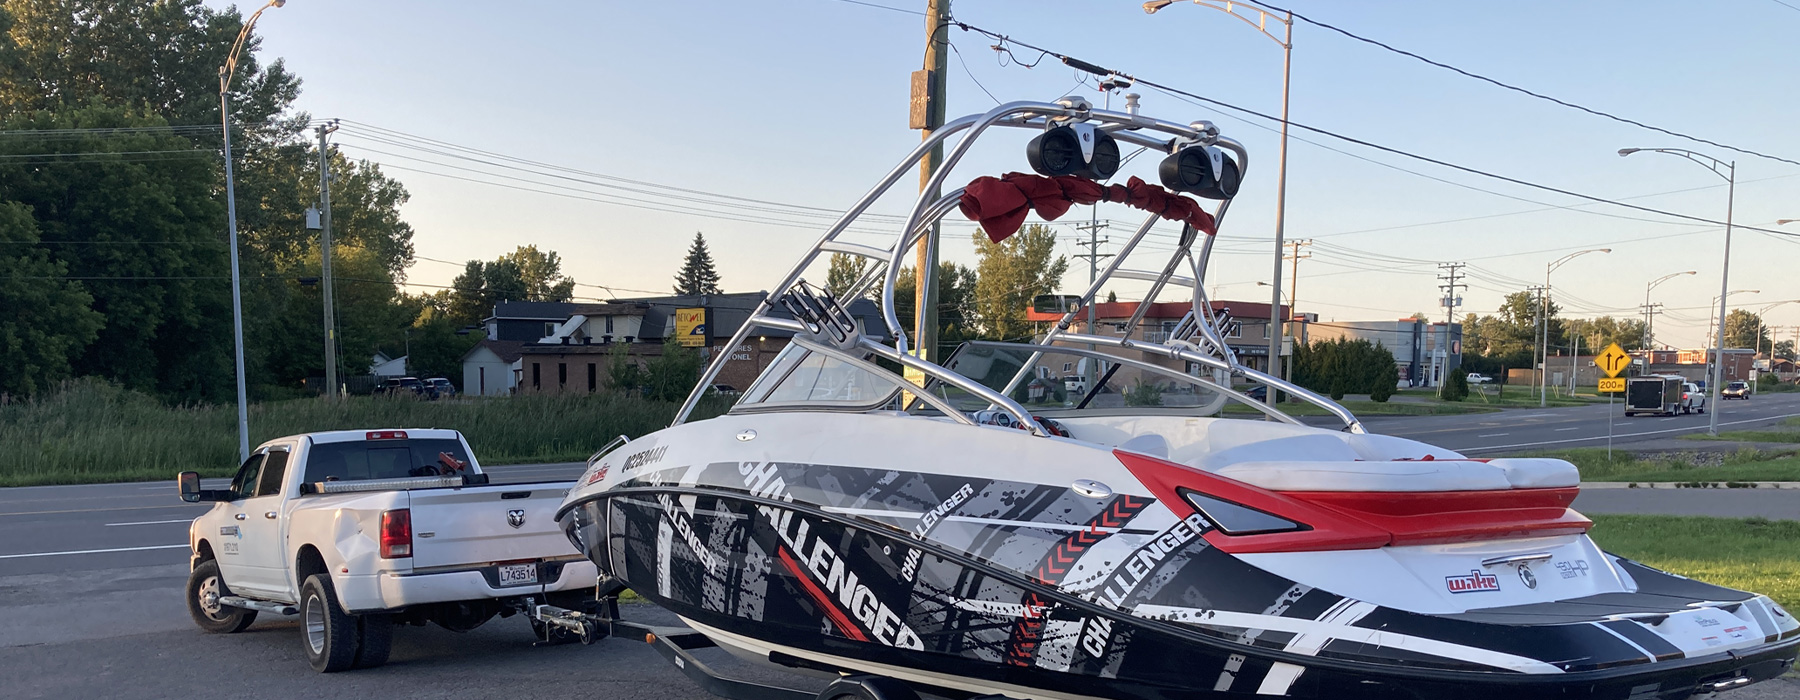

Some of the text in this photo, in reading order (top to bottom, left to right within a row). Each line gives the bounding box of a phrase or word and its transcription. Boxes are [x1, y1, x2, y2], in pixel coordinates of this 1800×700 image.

[1600, 381, 1617, 389] 200
[500, 568, 535, 582] L743514
[1448, 571, 1497, 591] wake
[1082, 513, 1212, 659] CHALLENGER
